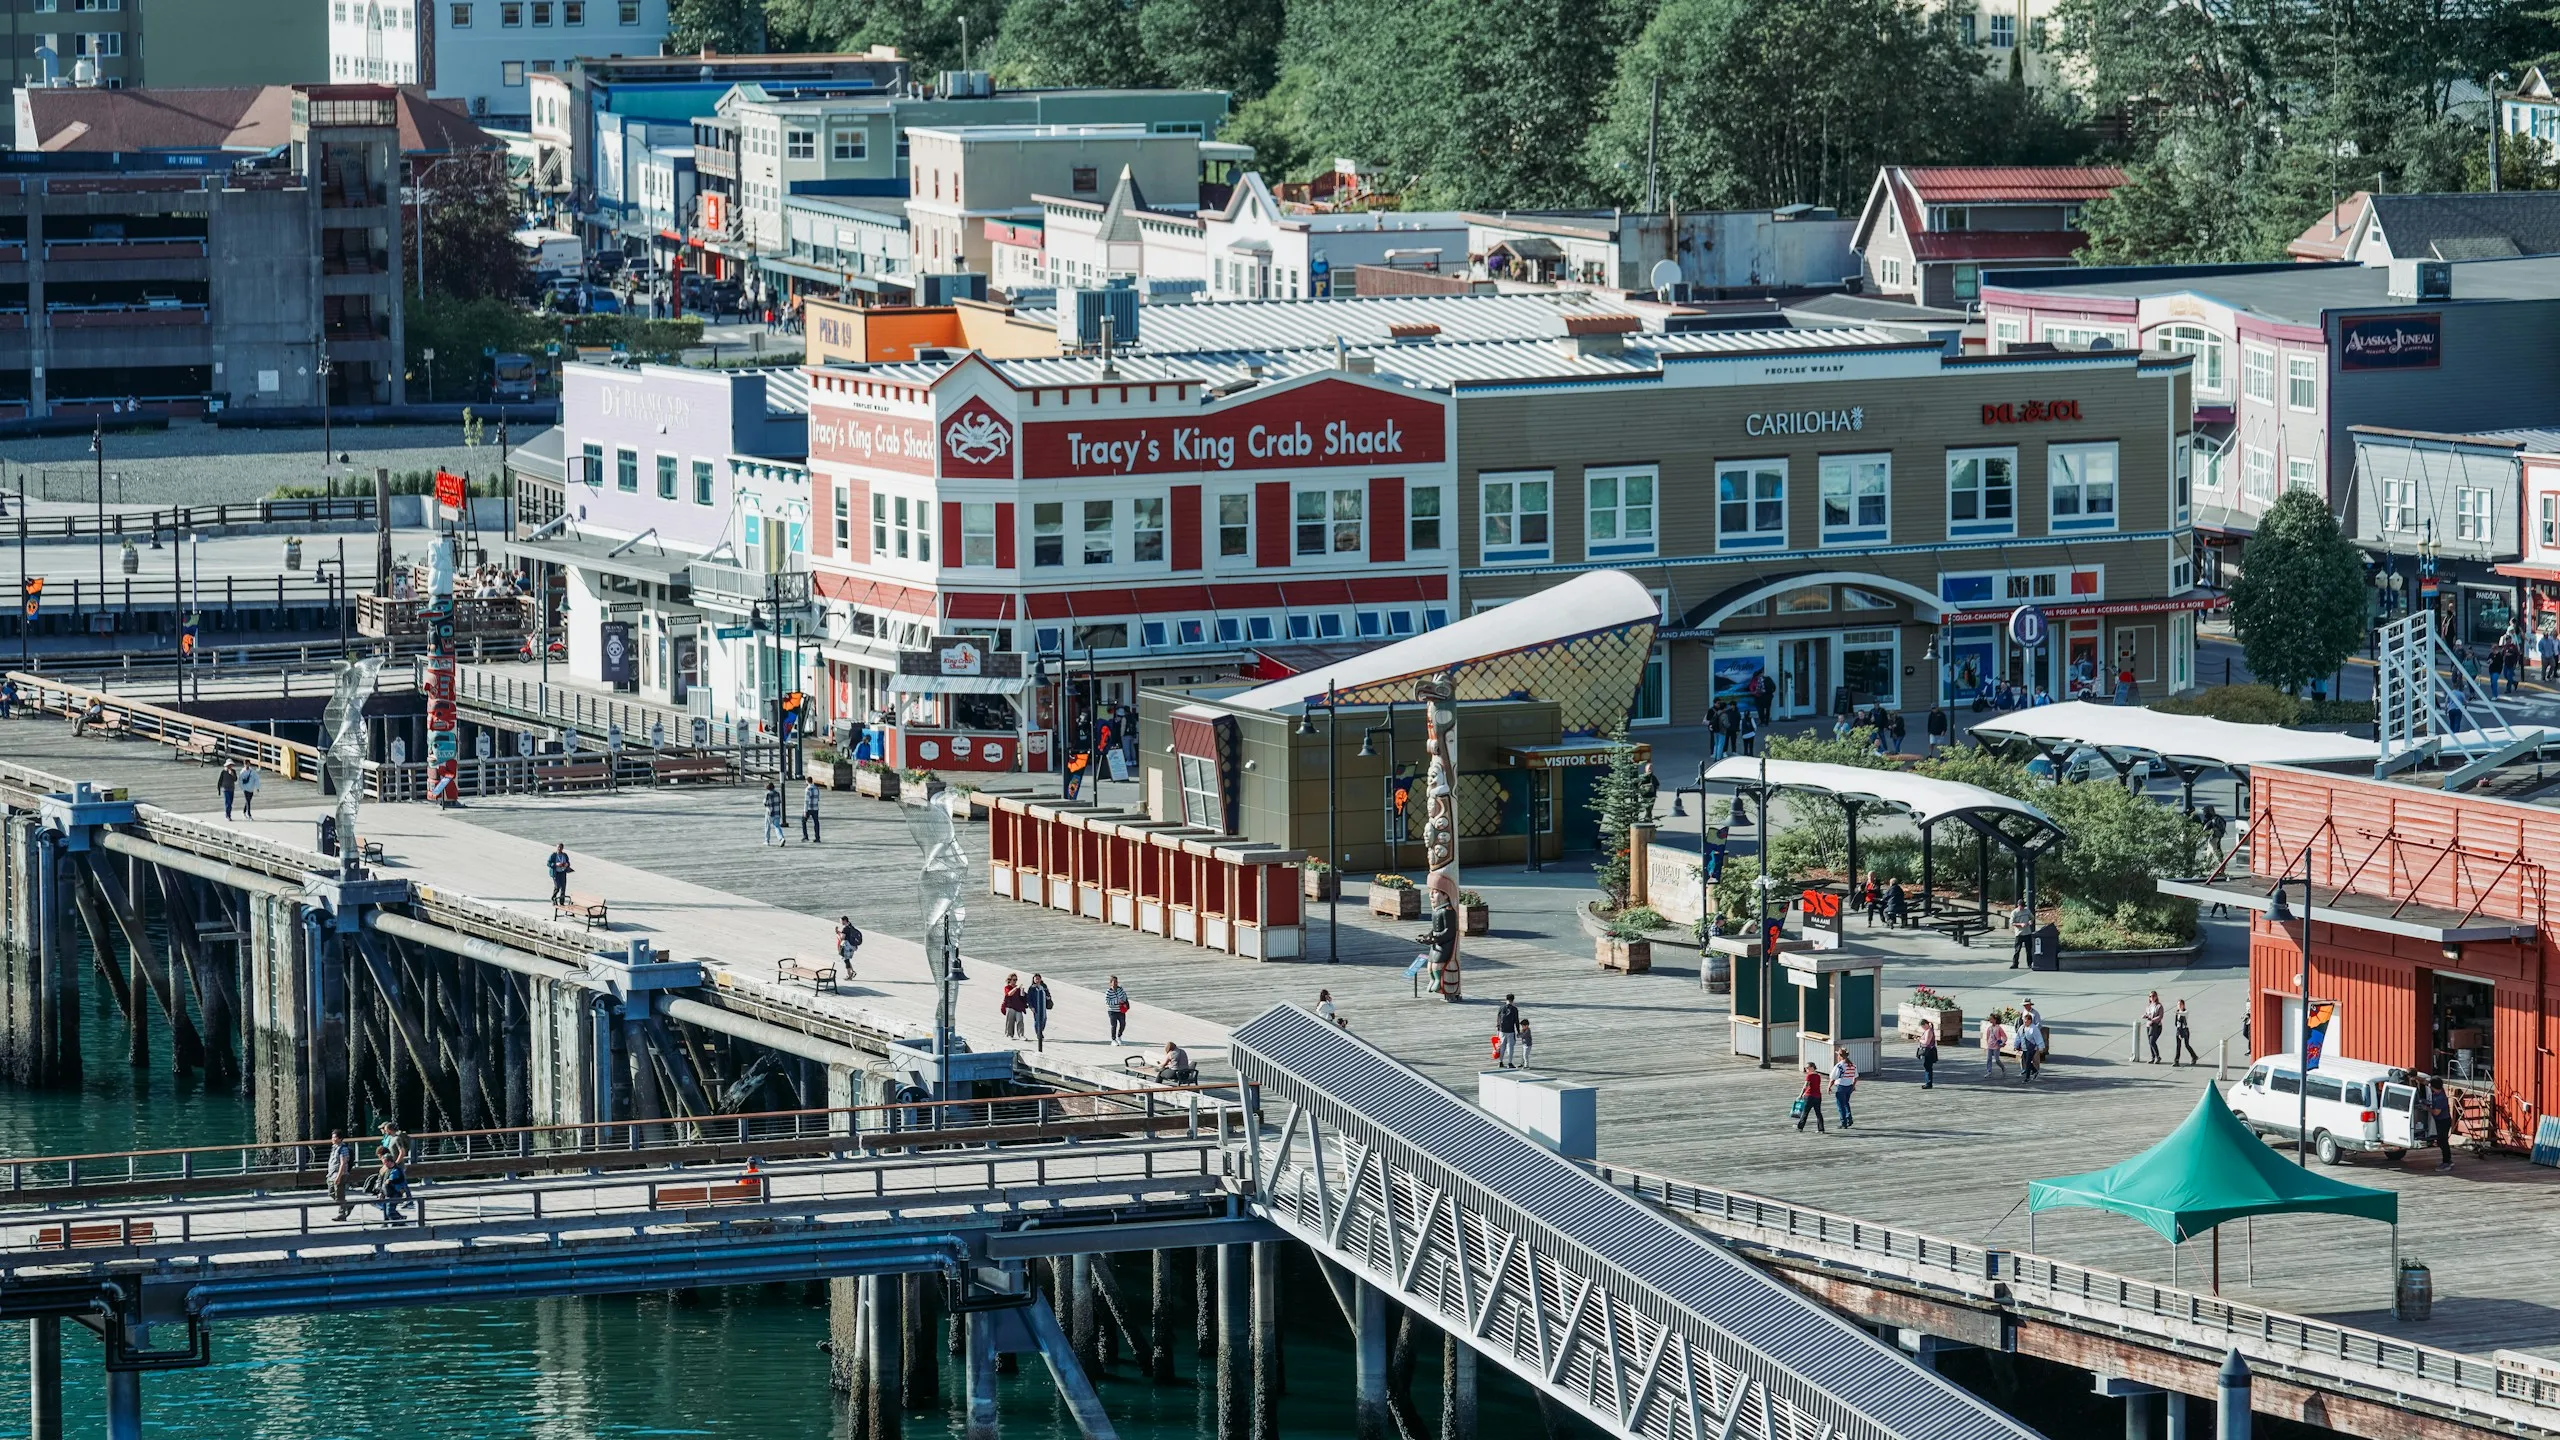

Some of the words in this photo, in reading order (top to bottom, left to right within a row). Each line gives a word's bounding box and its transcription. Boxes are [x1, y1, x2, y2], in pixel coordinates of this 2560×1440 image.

[179, 156, 203, 164] PARKING
[819, 317, 839, 346] PIER
[1811, 365, 1844, 373] WHARF
[625, 389, 691, 415] DIAMONDS
[1982, 403, 2018, 425] DEL
[2043, 399, 2083, 422] SOL
[1746, 410, 1852, 436] CARILOHA
[811, 415, 844, 452] Tracy's
[849, 420, 872, 459] King
[875, 424, 900, 455] Crab
[904, 426, 935, 461] Shack
[1067, 429, 1160, 472] Tracy's
[1173, 427, 1235, 469] King
[1248, 421, 1313, 458] Crab
[1324, 418, 1403, 455] Shack
[2475, 592, 2501, 601] PANDORA
[2056, 608, 2080, 616] POLISH,
[2097, 604, 2139, 613] ACCESSORIES,
[2141, 603, 2180, 612] SUNGLASSES
[1661, 631, 1678, 639] AND
[2025, 614, 2038, 641] D
[1544, 755, 1587, 767] VISITOR
[1650, 863, 1680, 887] JUNEAU
